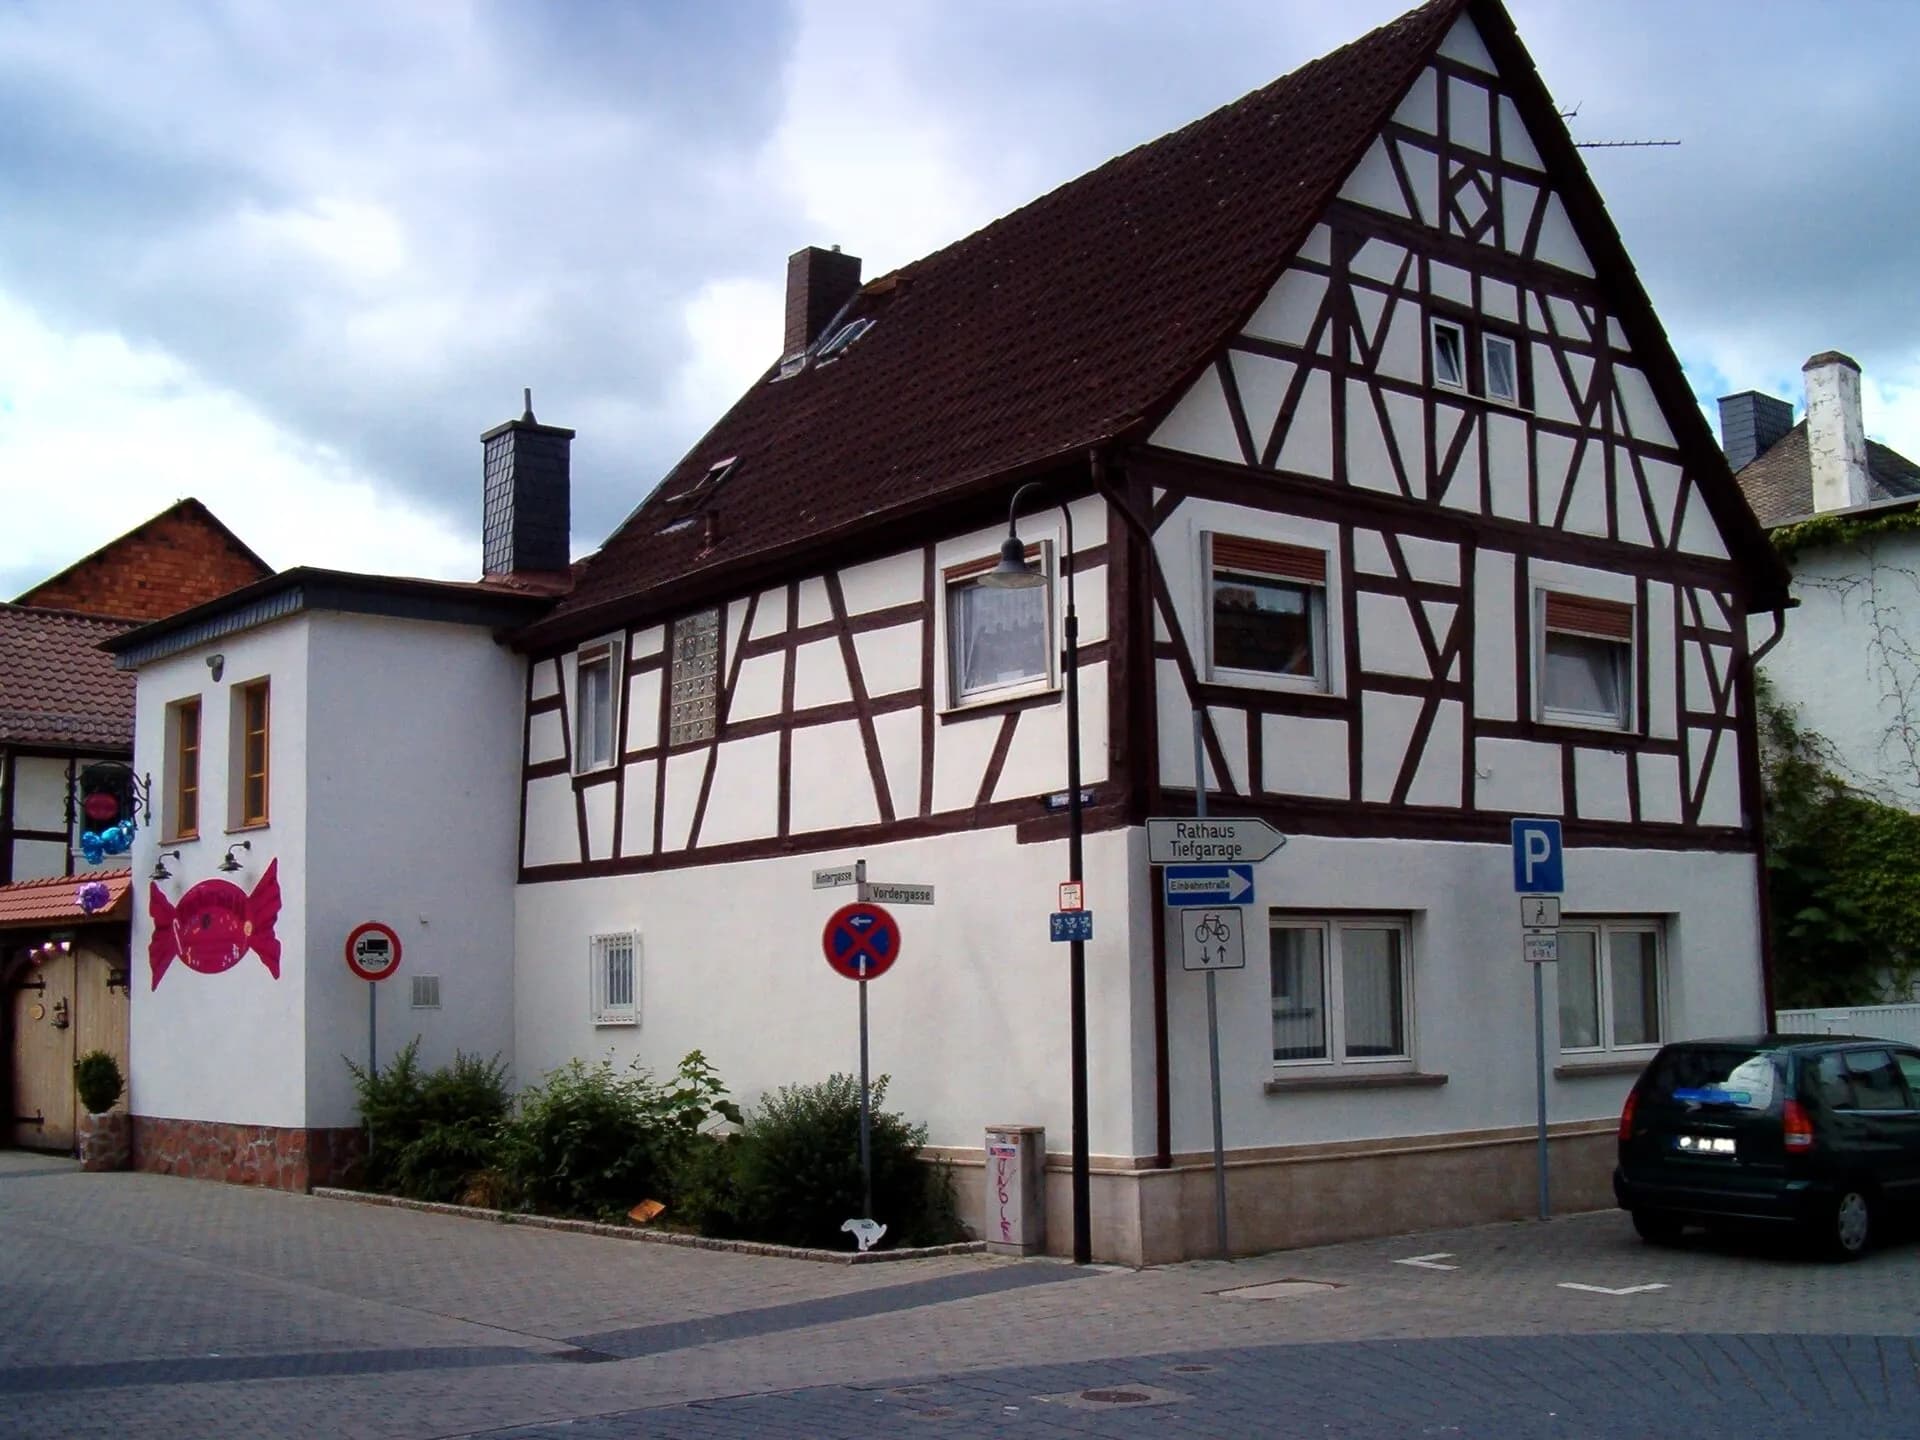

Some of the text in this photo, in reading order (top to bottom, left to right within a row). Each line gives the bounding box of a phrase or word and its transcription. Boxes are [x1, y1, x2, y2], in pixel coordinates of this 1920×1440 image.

[1176, 823, 1235, 839] Rathaus
[1169, 841, 1242, 860] Tiefgarage
[1524, 829, 1551, 883] P
[1171, 880, 1230, 890] Einbahnstraße
[873, 887, 930, 901] Vordergasse
